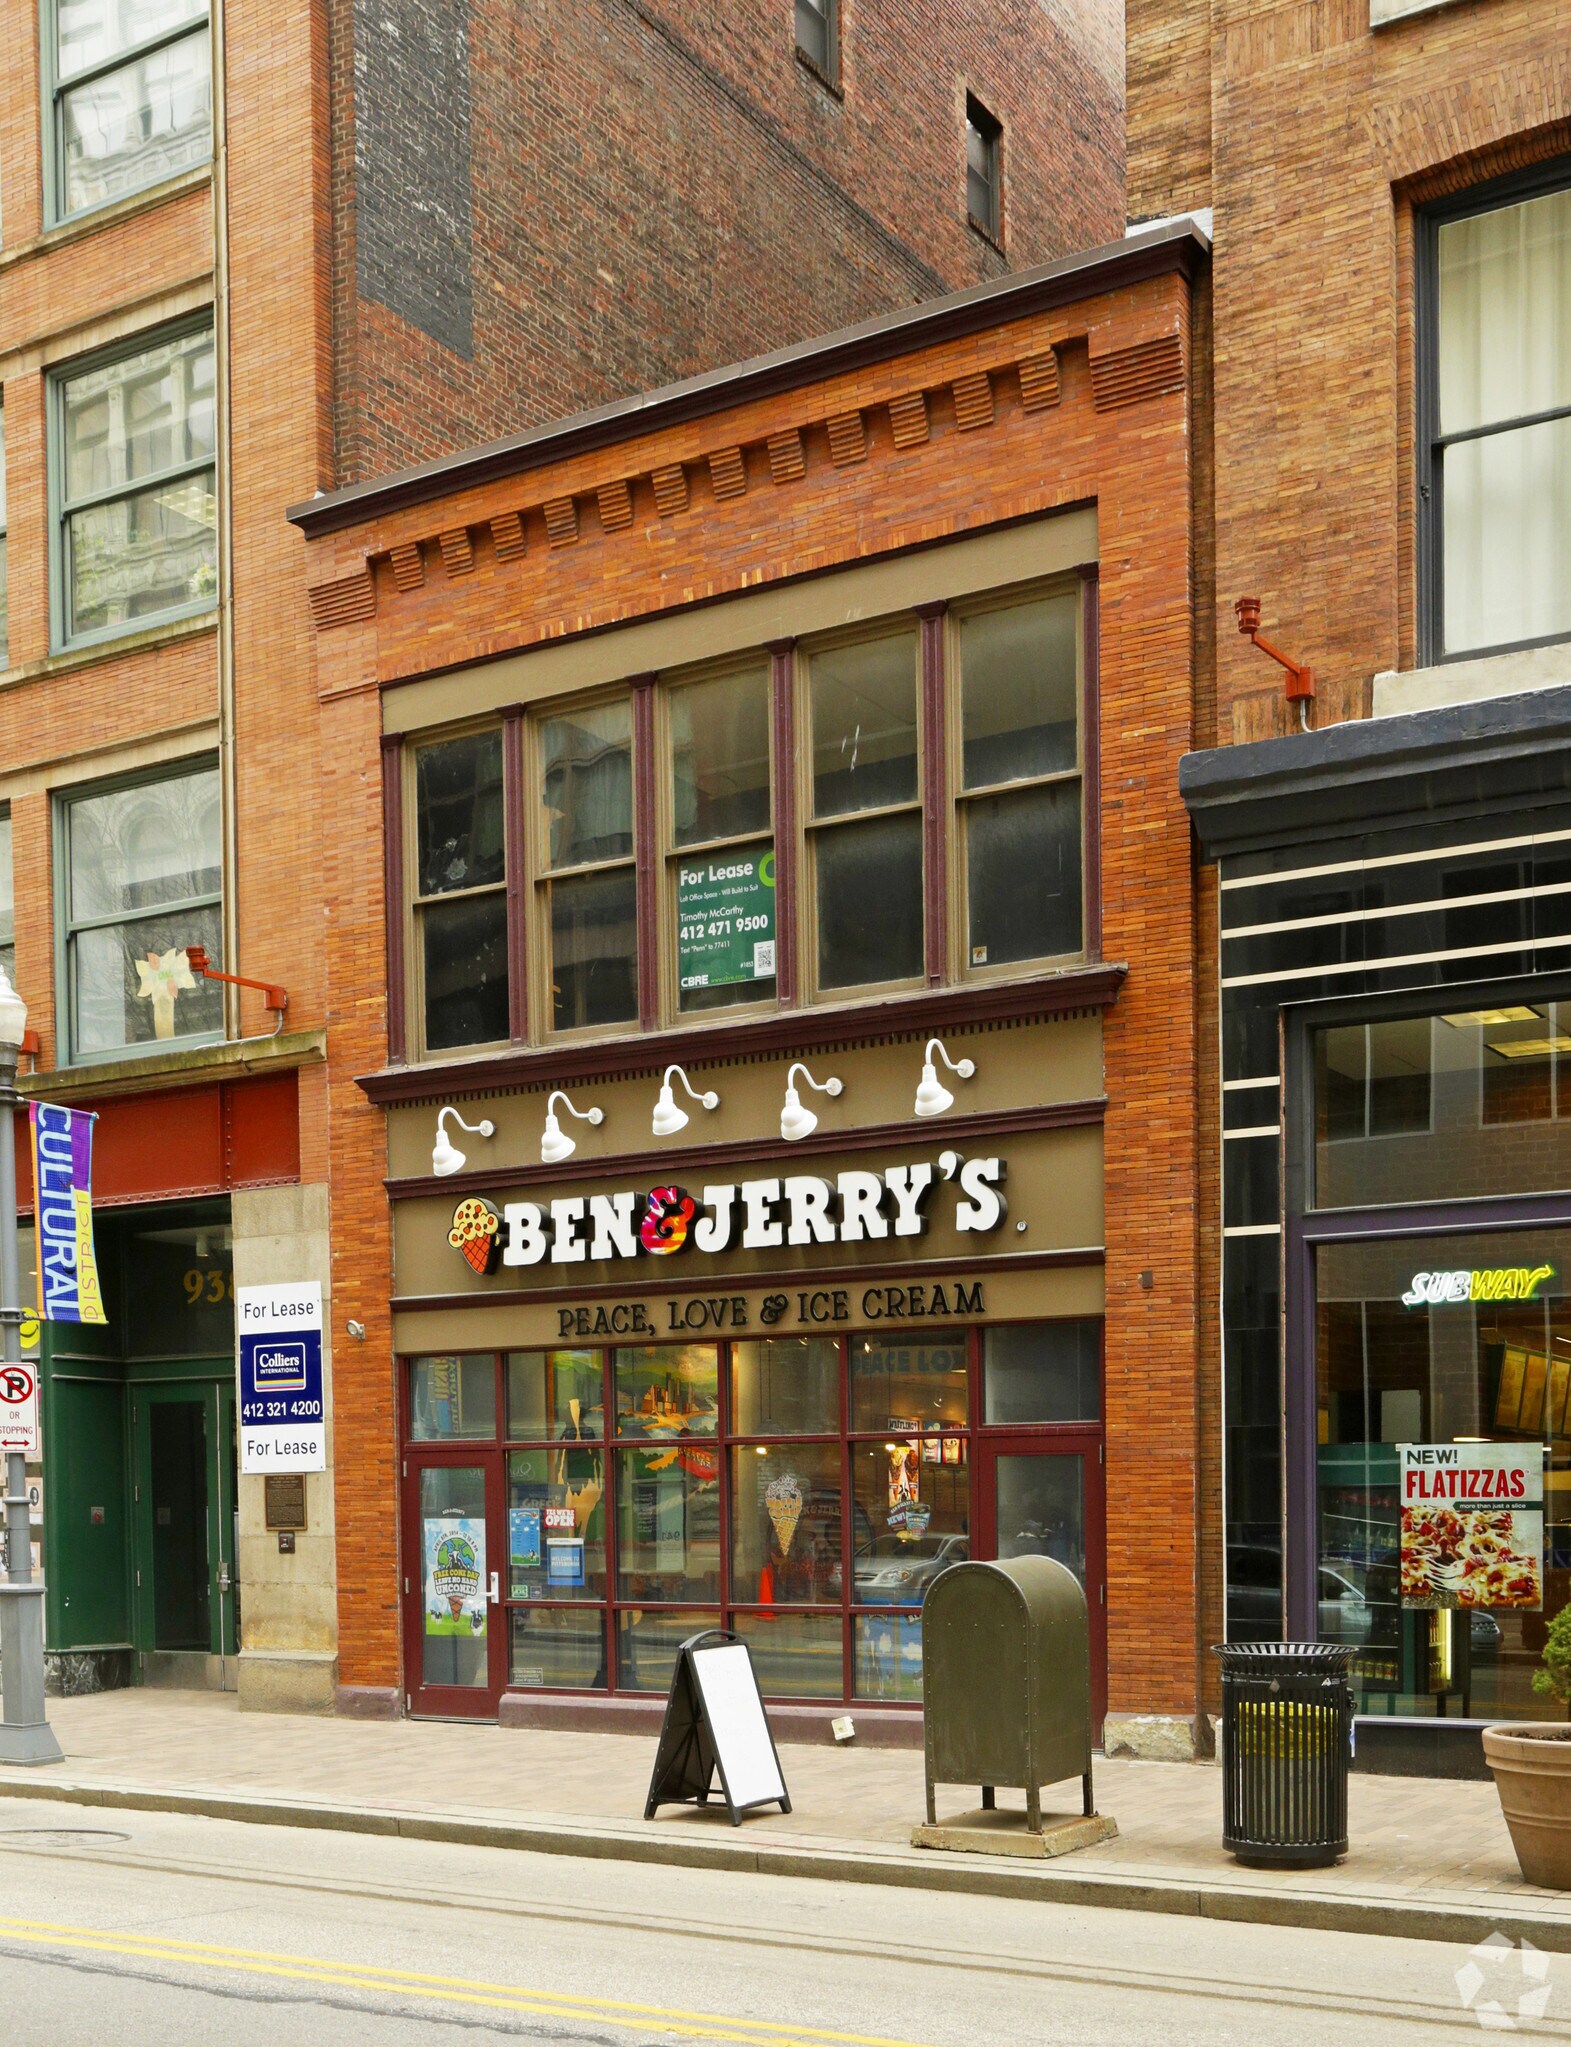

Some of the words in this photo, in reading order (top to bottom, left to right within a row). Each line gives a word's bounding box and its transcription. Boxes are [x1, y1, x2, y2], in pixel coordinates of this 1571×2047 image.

[680, 869, 705, 886] For
[708, 863, 753, 881] Lease
[680, 910, 707, 922] Timothy
[709, 905, 744, 919] McCarthy
[680, 925, 704, 940] 412
[708, 920, 730, 936] 471
[736, 914, 768, 932] 9500
[680, 974, 709, 987] CBRE
[37, 1102, 81, 1321] CULTURAL
[503, 1191, 642, 1267] BEN
[640, 1185, 697, 1256] &
[694, 1150, 1007, 1253] JERRY'S
[77, 1193, 99, 1321] DISTRICT
[183, 1269, 235, 1304] 93
[1402, 1265, 1552, 1306] SUBWAY
[244, 1303, 267, 1319] For
[271, 1301, 314, 1317] Lease
[557, 1302, 657, 1337] PEACE,
[668, 1296, 749, 1330] LOVE
[760, 1293, 789, 1325] &
[797, 1290, 850, 1322] ICE
[862, 1281, 987, 1320] CREAM
[259, 1352, 300, 1368] Colliers
[9, 1411, 20, 1420] OR
[243, 1402, 264, 1418] 412
[267, 1401, 287, 1416] 321
[290, 1400, 321, 1416] 4200
[247, 1440, 270, 1456] For
[275, 1439, 317, 1455] Lease
[1407, 1449, 1458, 1465] NEW!
[1406, 1469, 1525, 1498] FLATIZZAS
[546, 1515, 575, 1527] OPEN
